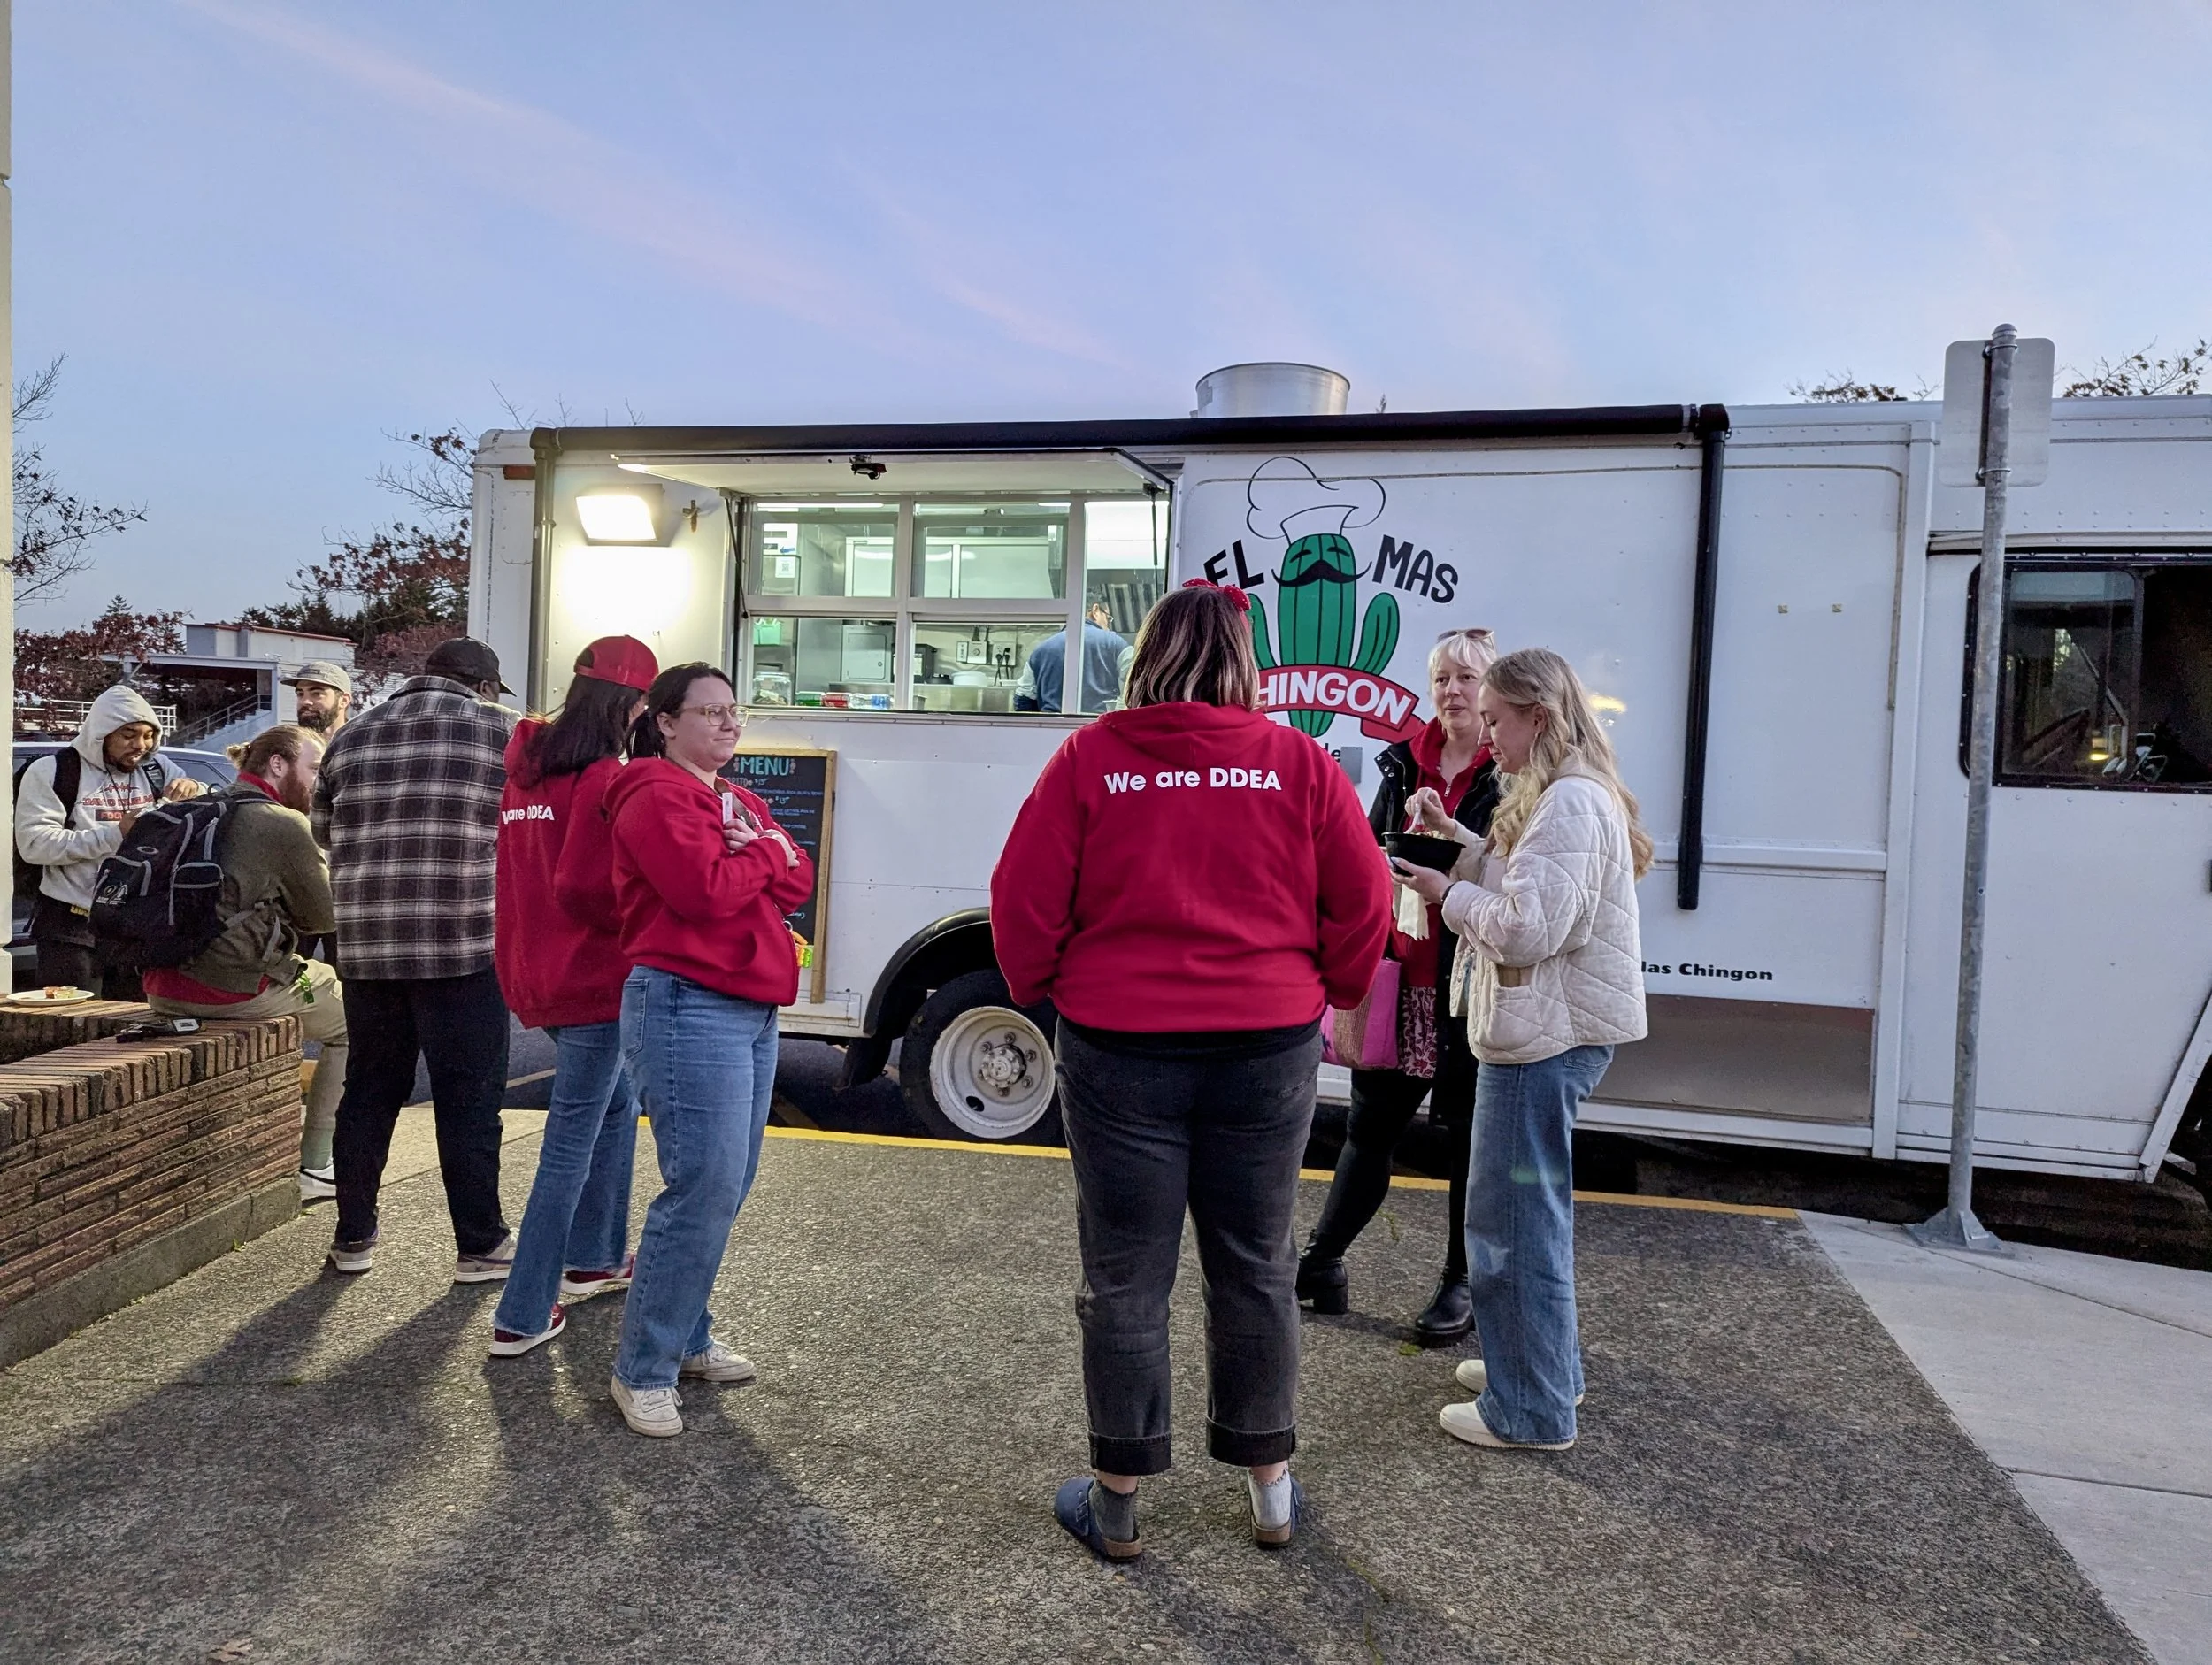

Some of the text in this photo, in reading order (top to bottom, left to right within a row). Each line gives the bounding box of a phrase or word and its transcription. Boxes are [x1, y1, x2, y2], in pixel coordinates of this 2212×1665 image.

[1203, 534, 1459, 603] EL MAS
[1259, 671, 1413, 725] HINGON
[740, 756, 790, 776] MENU
[1103, 767, 1282, 794] We are DDEA
[1678, 963, 1773, 981] Chingon
